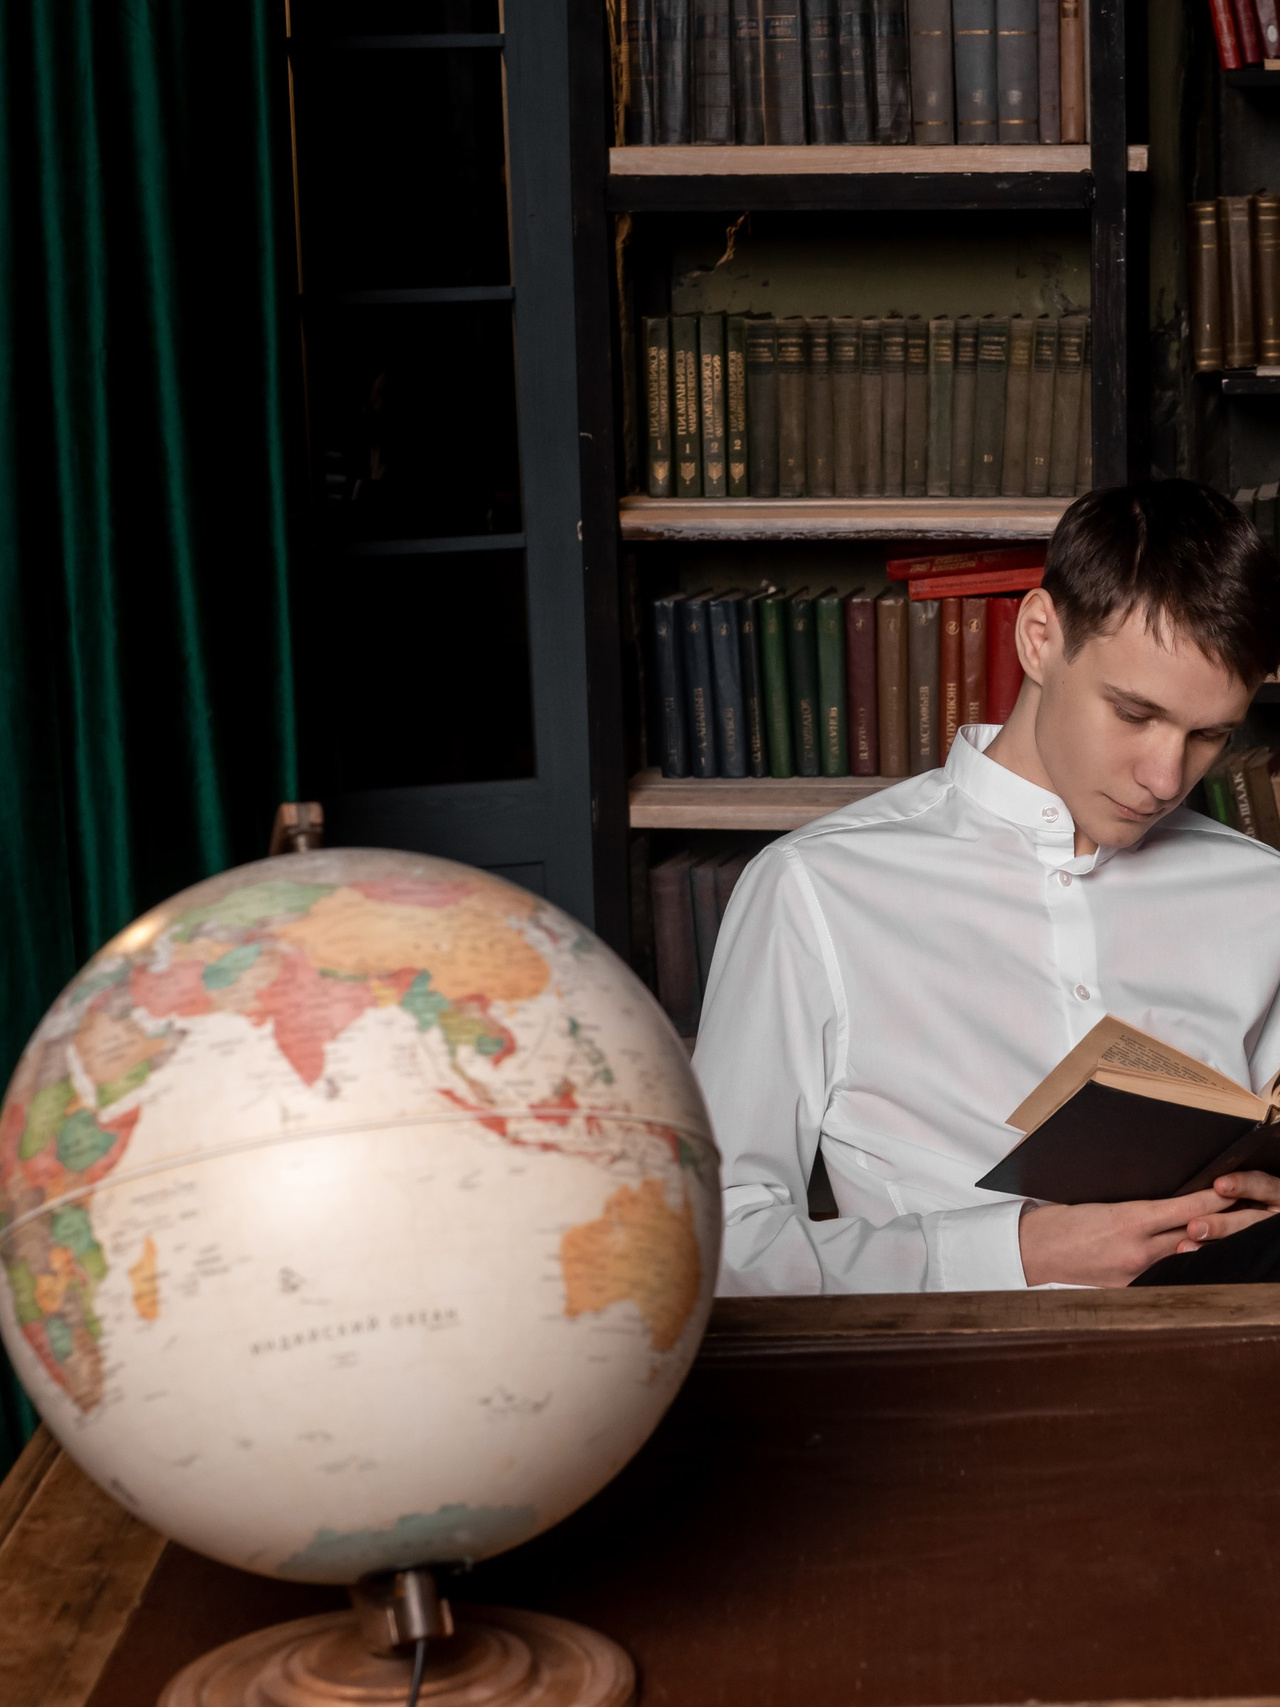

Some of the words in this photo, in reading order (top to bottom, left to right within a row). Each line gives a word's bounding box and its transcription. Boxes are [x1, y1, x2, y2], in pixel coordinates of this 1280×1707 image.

[656, 440, 662, 451] 1
[685, 443, 691, 454] 1
[710, 442, 718, 453] 2
[733, 439, 741, 450] 2
[919, 686, 930, 744] АСТАФЬЕВ
[249, 1316, 380, 1356] ИНДИЙСКИЙ
[389, 1307, 459, 1330] ОКЕАН
